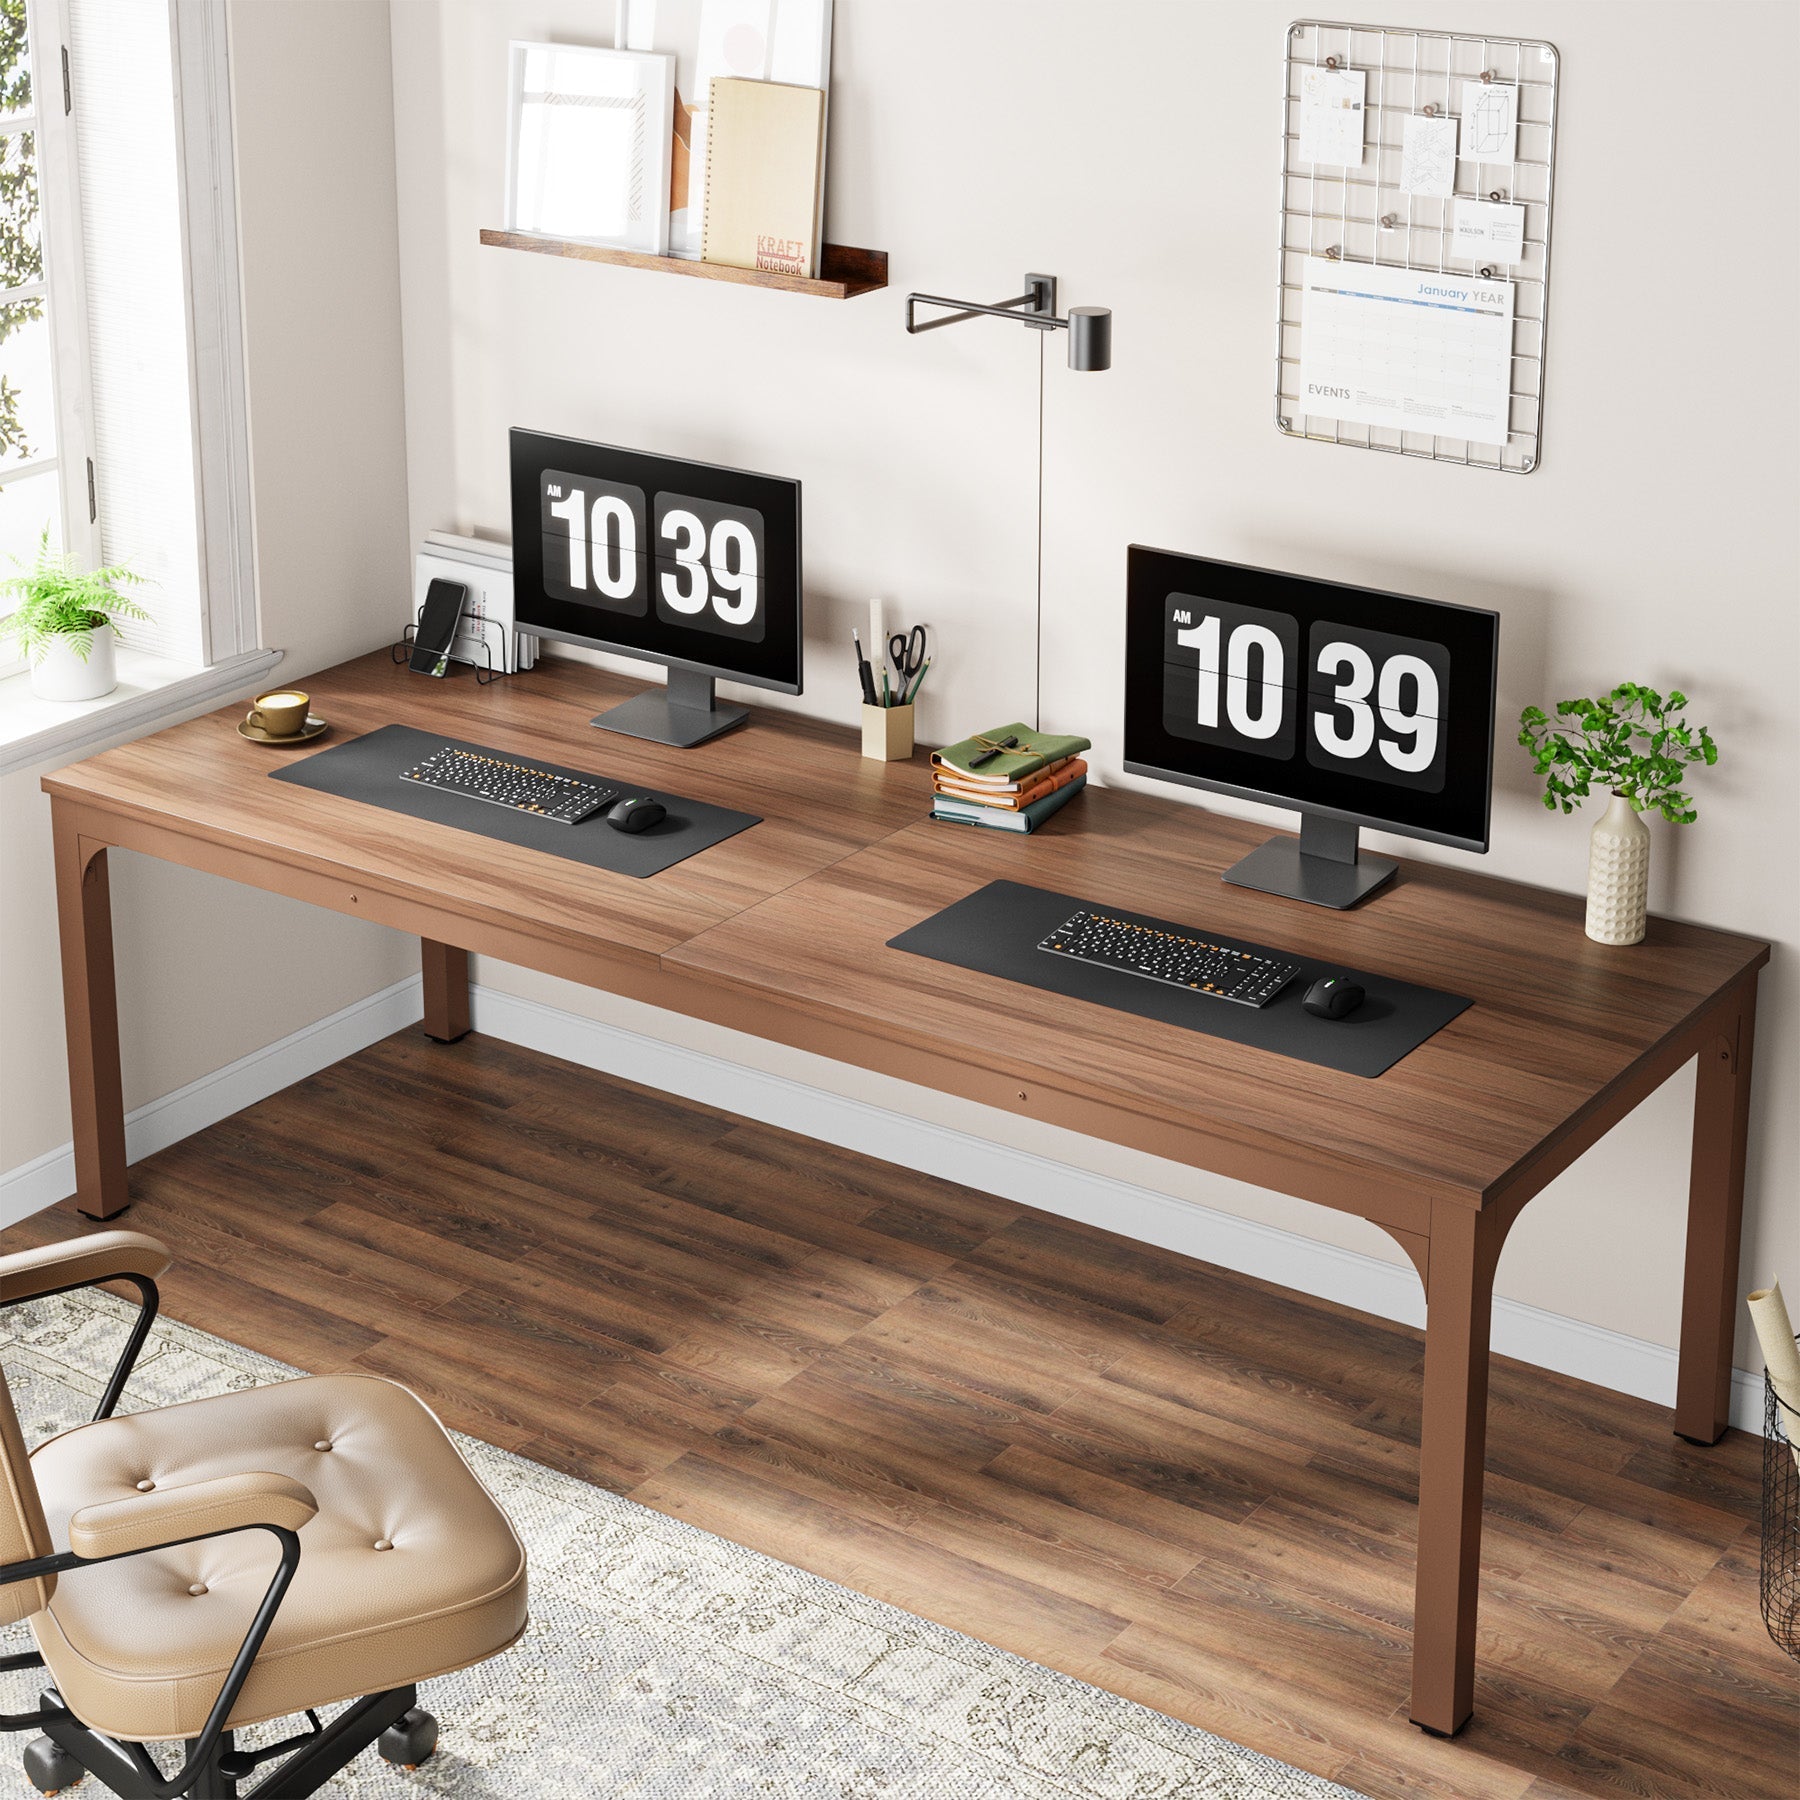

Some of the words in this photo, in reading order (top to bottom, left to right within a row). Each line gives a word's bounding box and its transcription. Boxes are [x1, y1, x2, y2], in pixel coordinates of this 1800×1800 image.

[757, 235, 804, 258] KRAFT
[756, 256, 802, 275] Notebook
[1417, 283, 1468, 301] January
[1473, 290, 1504, 305] YEAR
[1308, 383, 1350, 399] EVENTS
[547, 484, 562, 498] AM
[551, 489, 637, 599] 10
[661, 509, 758, 625] 39
[1173, 609, 1191, 624] AM
[1177, 615, 1284, 740] 10
[1314, 641, 1439, 773] 39
